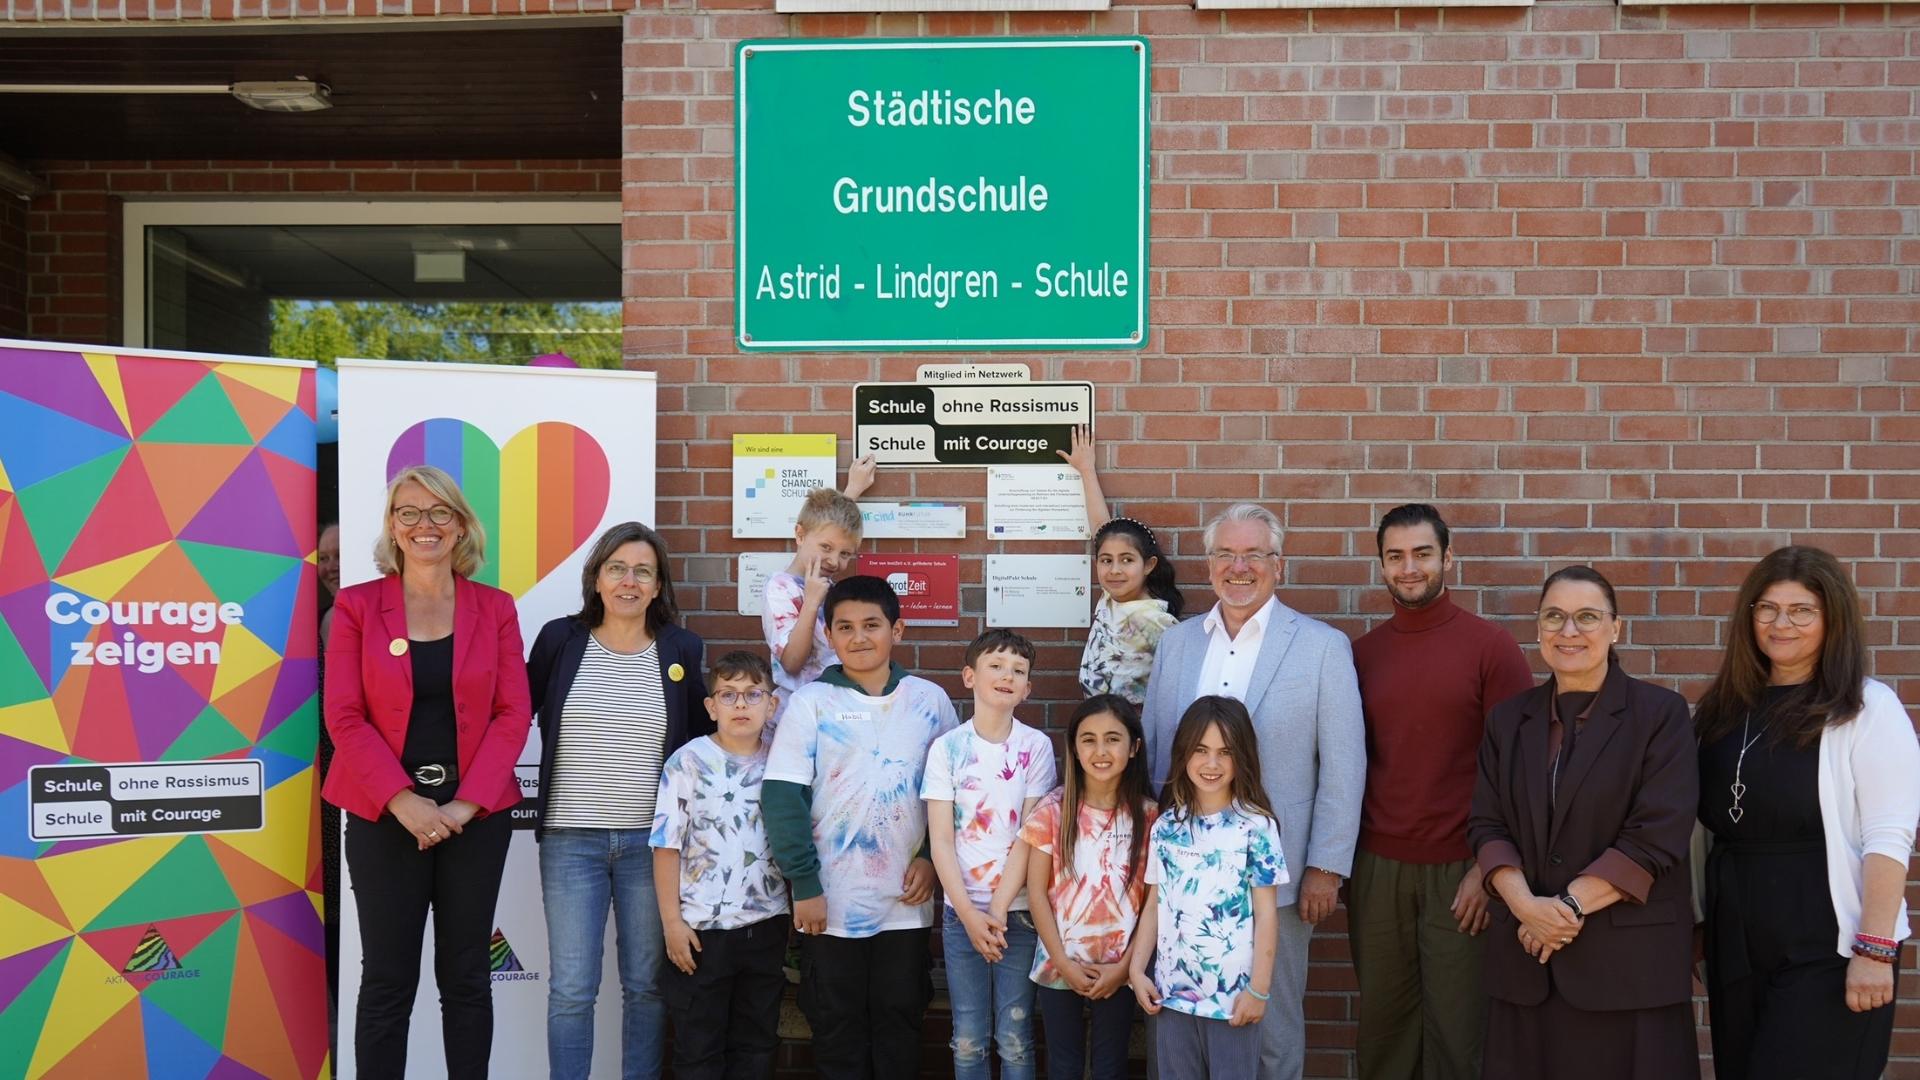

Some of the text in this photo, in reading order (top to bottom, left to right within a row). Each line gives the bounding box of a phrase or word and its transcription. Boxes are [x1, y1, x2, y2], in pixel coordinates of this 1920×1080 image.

[847, 89, 1036, 127] Städtische
[832, 176, 1049, 214] Grundschule
[756, 263, 841, 300] Astrid
[876, 263, 998, 309] Lindgren
[1034, 262, 1129, 298] Schule
[923, 370, 1024, 381] Mitglied im Netzwerk
[868, 398, 1080, 415] Schule ohne Rassismus
[868, 436, 1049, 454] Schule mit Courage
[781, 469, 808, 478] START
[781, 479, 824, 488] CHANCEN
[781, 488, 808, 498] SCHUL
[861, 511, 873, 521] ir
[873, 510, 895, 522] sind
[44, 592, 244, 634] Courage
[70, 632, 221, 674] zeigen
[44, 774, 250, 793] Schule ohne Rassismus
[45, 807, 222, 826] Schule mit Courage
